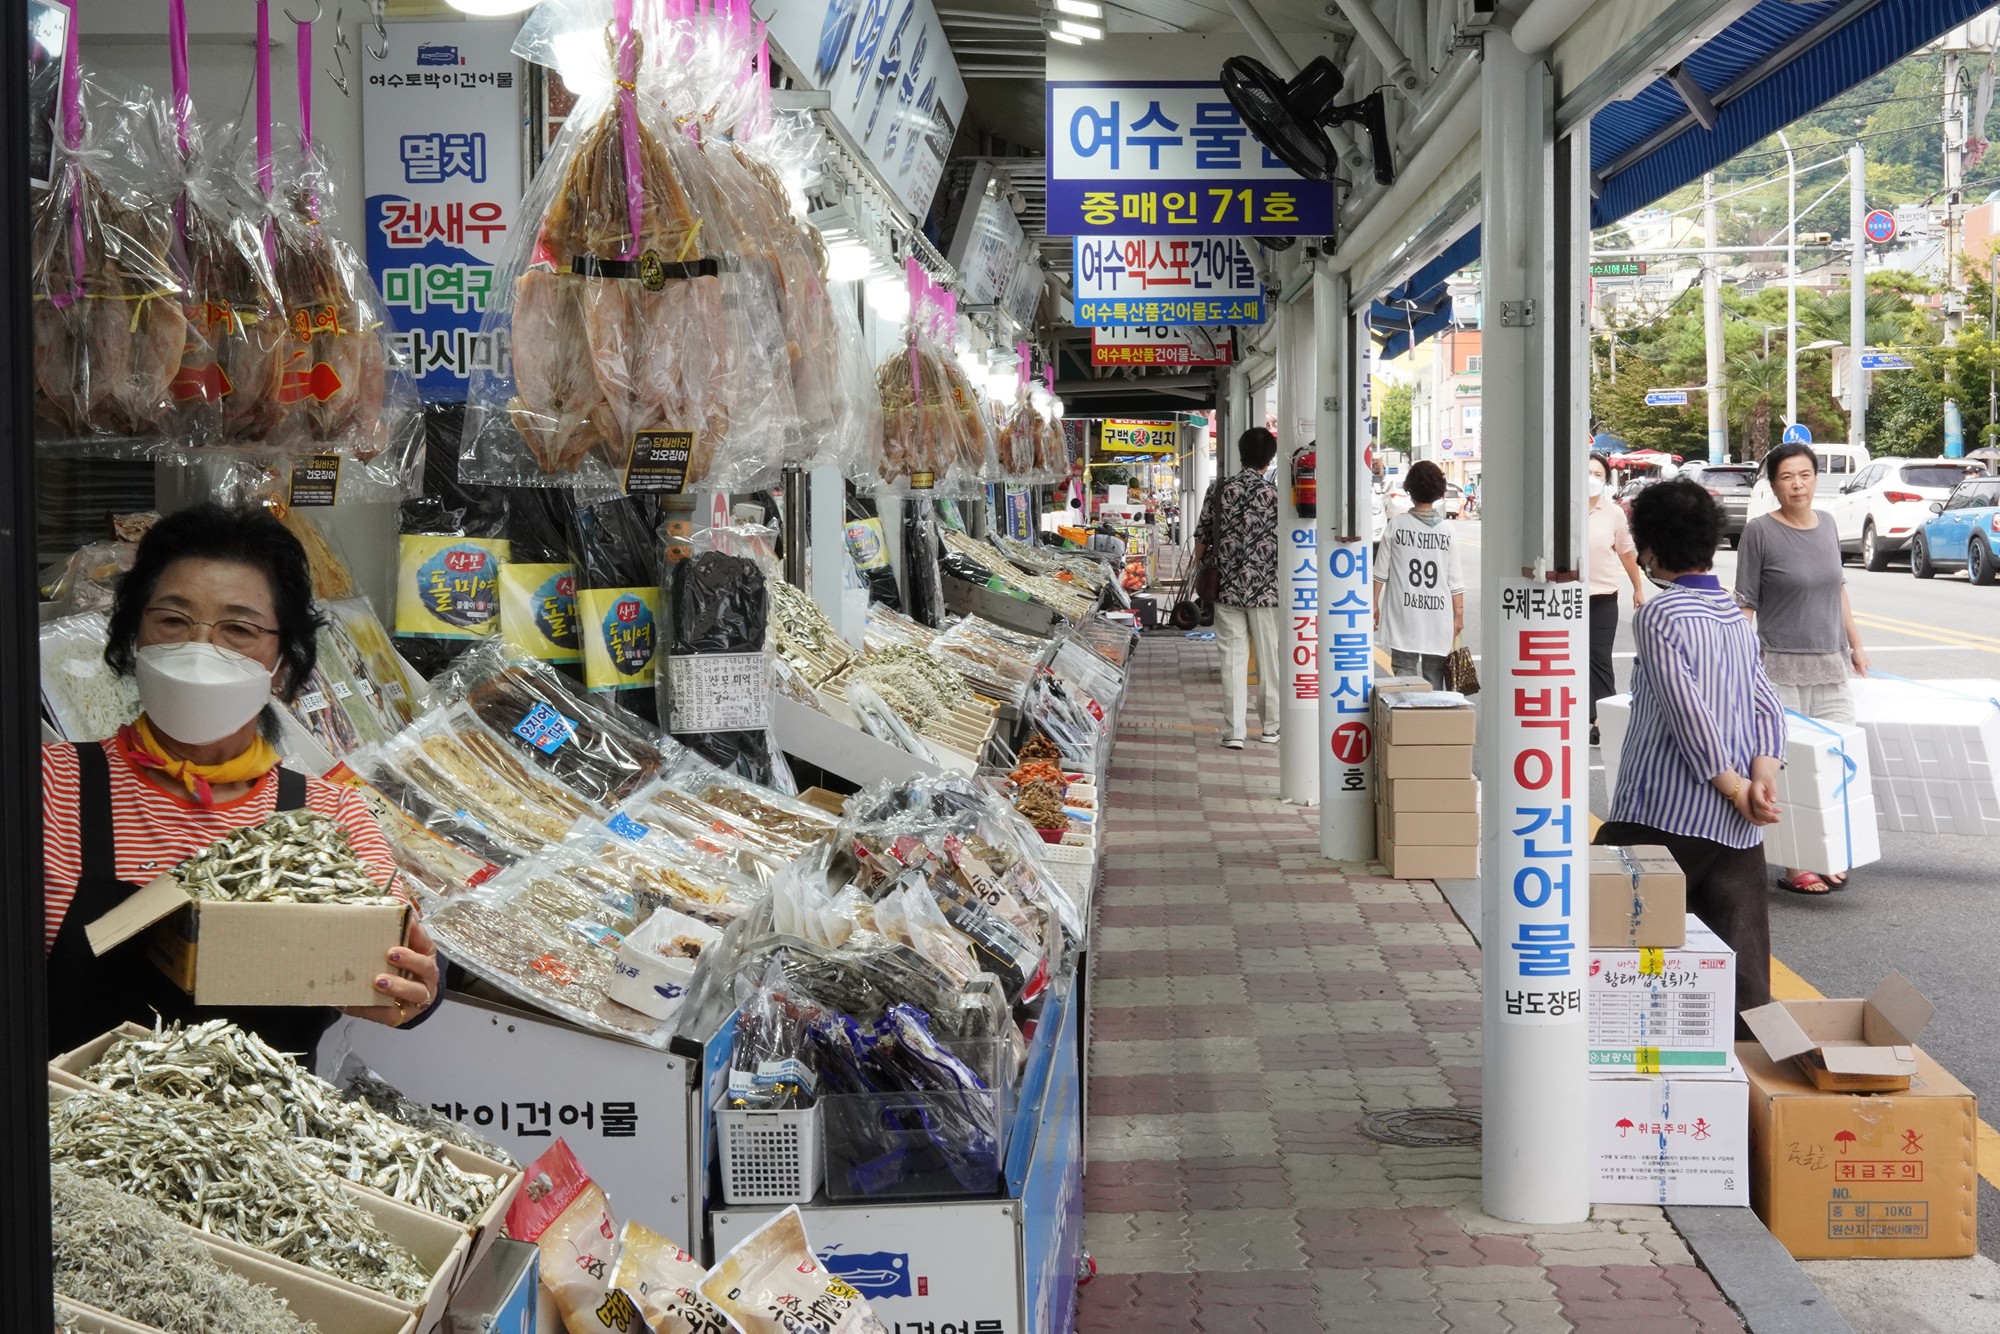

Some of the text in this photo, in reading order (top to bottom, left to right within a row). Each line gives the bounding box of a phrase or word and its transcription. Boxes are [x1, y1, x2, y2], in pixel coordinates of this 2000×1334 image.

[370, 72, 513, 89] 여수토박이건어물
[1070, 101, 1289, 170] 여수물
[402, 134, 485, 182] 멸치
[1081, 189, 1299, 224] 중매인 71호
[383, 202, 507, 244] 건새우
[1082, 239, 1255, 291] 여수엑스포건어물
[388, 332, 507, 376] 다시마
[650, 450, 688, 461] 건오징어
[307, 470, 336, 480] 건오징어
[1395, 528, 1451, 551] SUN SHINES
[450, 555, 482, 571] 산모
[1409, 558, 1438, 589] 89
[620, 604, 637, 620] 산모
[1403, 592, 1445, 611] D&BKIDS
[1502, 588, 1584, 621] 우체국쇼핑몰
[610, 622, 651, 663] 돌미역
[1329, 546, 1371, 714] 여수물산
[519, 705, 554, 739] 오징어
[1511, 630, 1577, 976] 토박이건어물
[1604, 971, 1699, 988] 황태껍질튀각
[1505, 989, 1581, 1016] 남도장터
[1638, 1123, 1687, 1134] 취급주의
[1841, 1165, 1915, 1178] 취급주의
[1833, 1188, 1852, 1199] NO.
[1884, 1206, 1912, 1217] 10KG
[1832, 1225, 1865, 1235] 원산지
